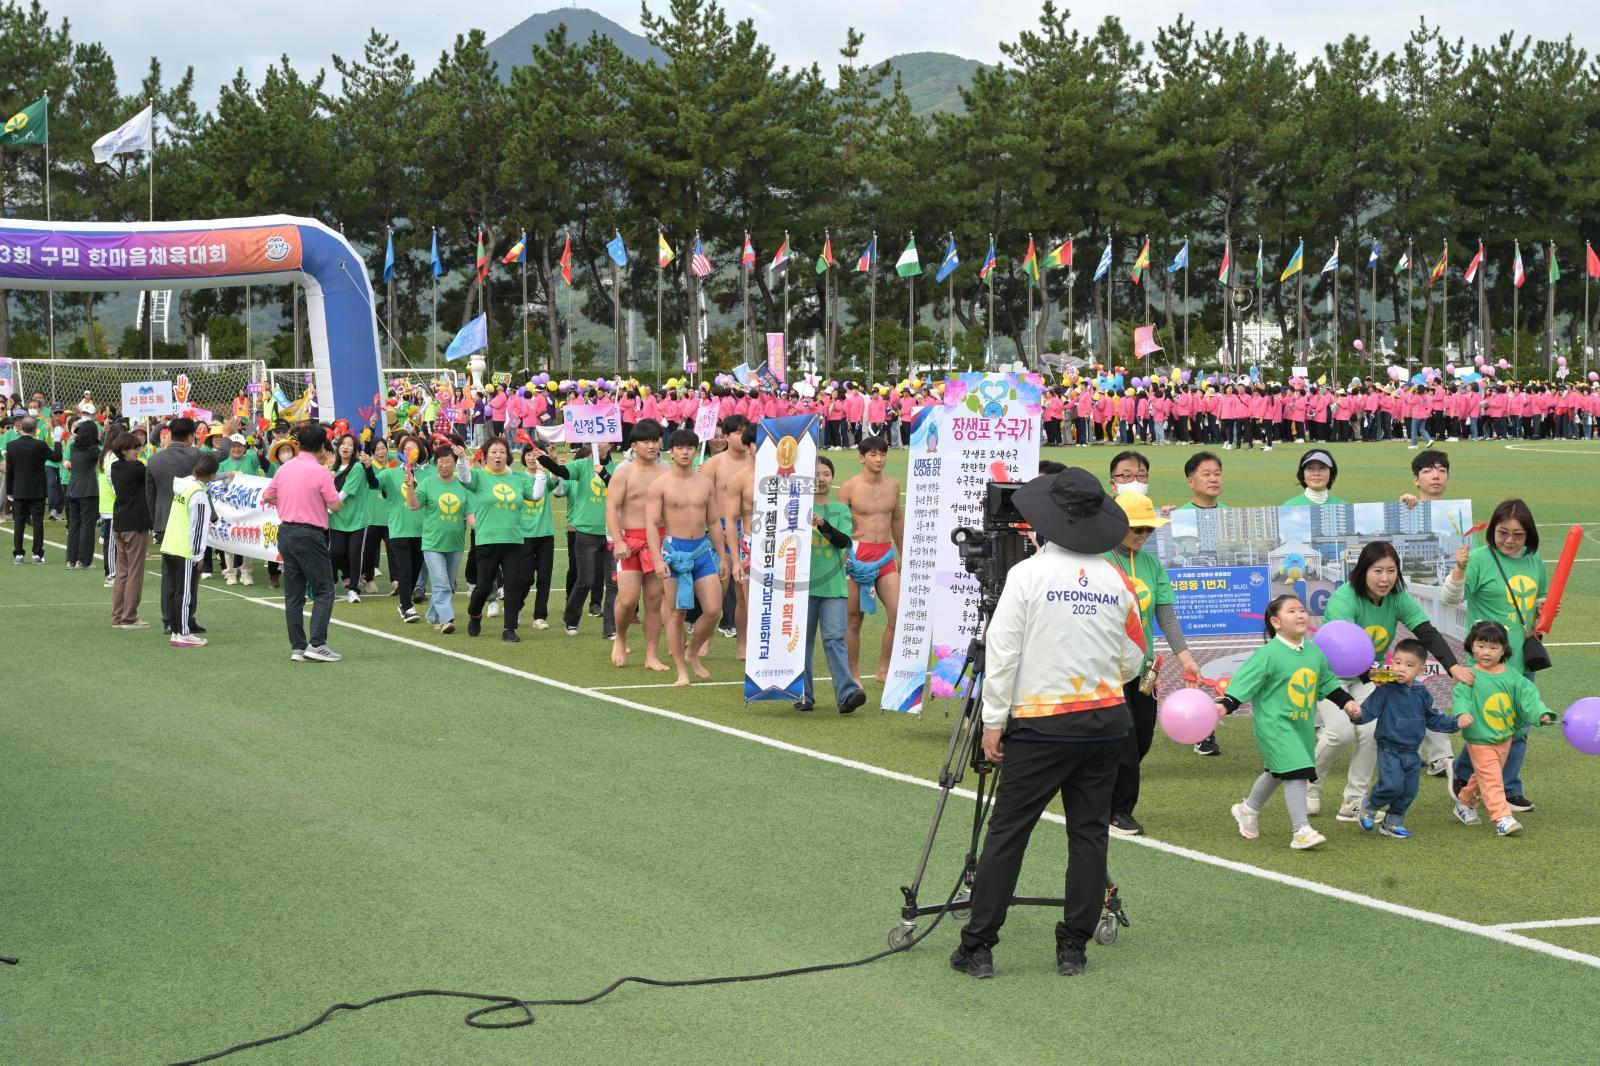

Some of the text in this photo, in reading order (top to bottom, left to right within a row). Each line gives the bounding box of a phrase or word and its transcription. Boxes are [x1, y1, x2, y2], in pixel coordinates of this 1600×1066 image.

[41, 246, 80, 267] 구민
[88, 243, 227, 267] 한마음체육대회
[573, 416, 618, 434] 신정5동
[952, 417, 1032, 441] 장생포 수국가
[962, 449, 1019, 461] 장생포 오색수국
[960, 462, 986, 473] 찬란한
[957, 516, 985, 527] 문화마
[954, 571, 971, 580] 다시
[1046, 590, 1119, 606] GYEONGNAM
[1072, 604, 1097, 615] 2025
